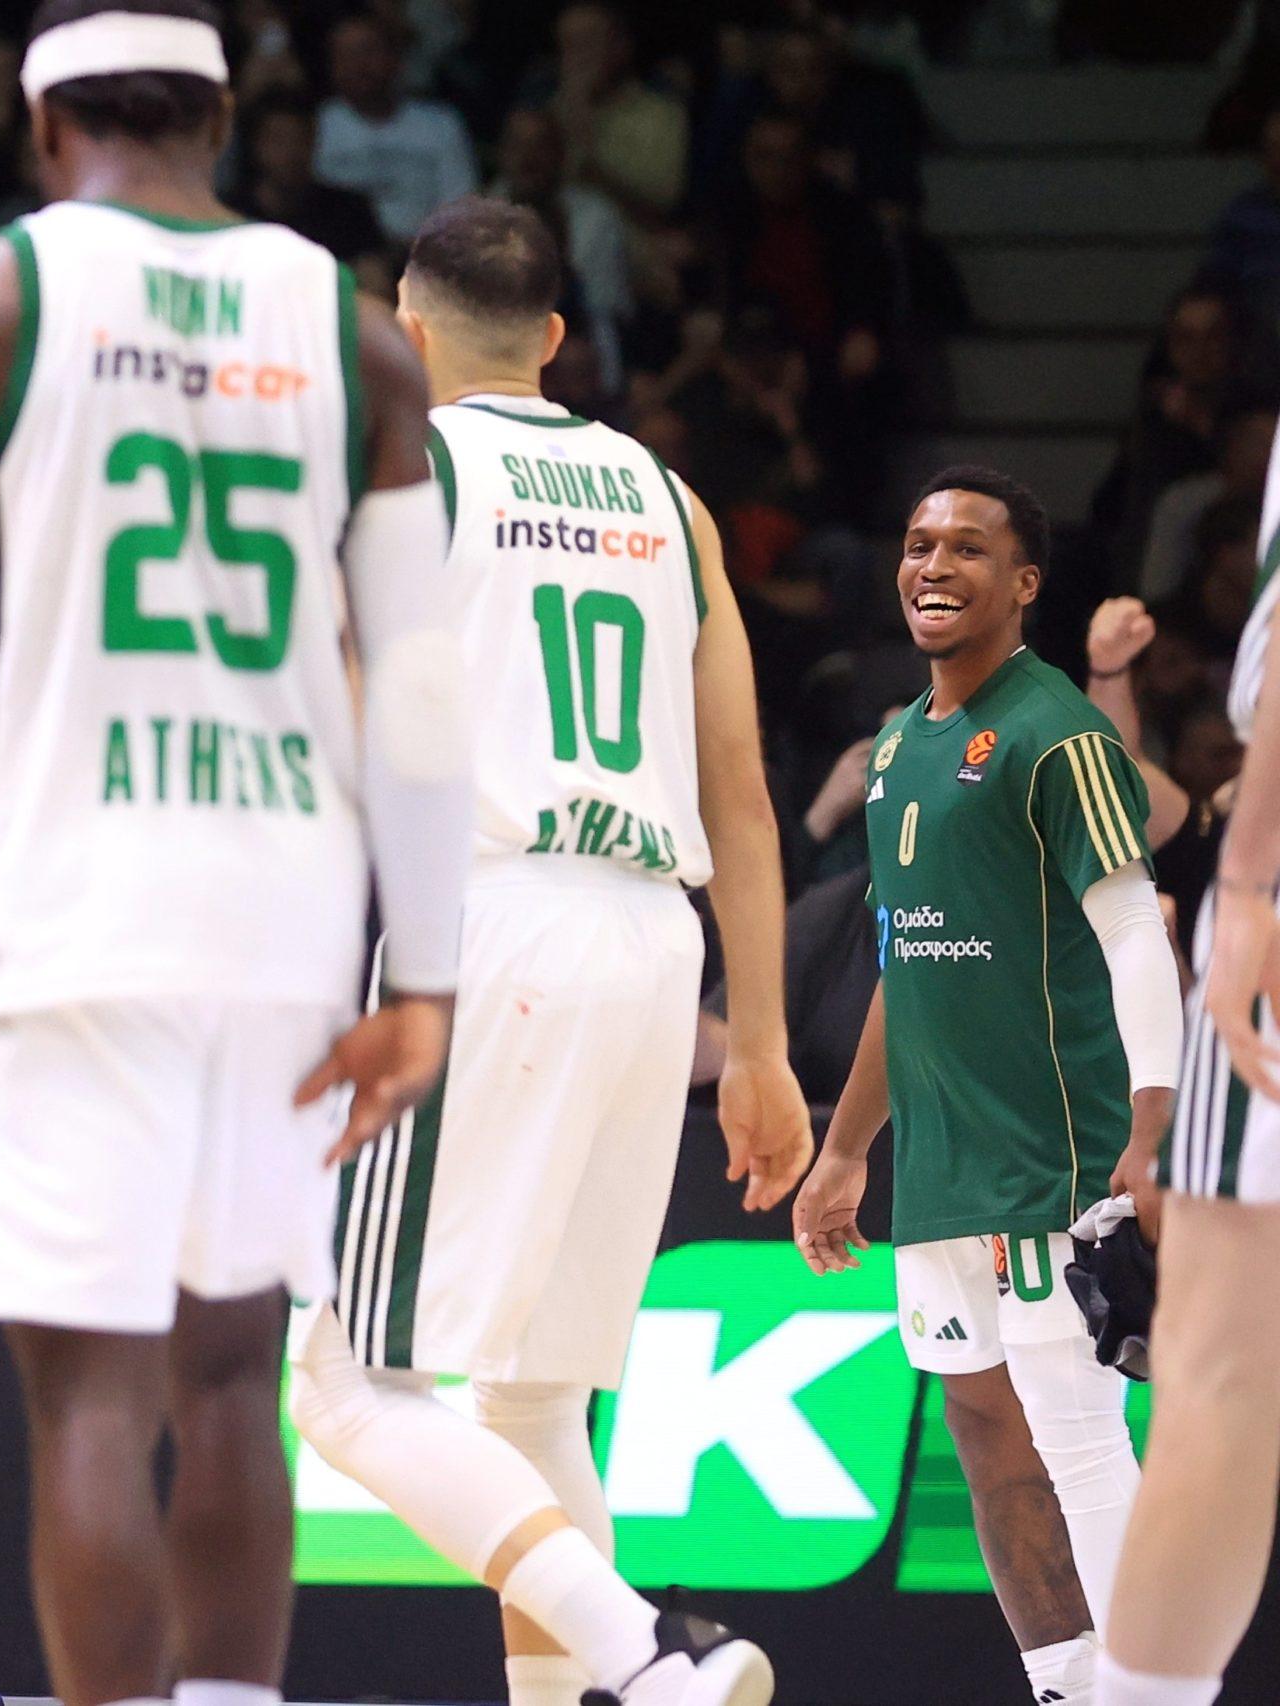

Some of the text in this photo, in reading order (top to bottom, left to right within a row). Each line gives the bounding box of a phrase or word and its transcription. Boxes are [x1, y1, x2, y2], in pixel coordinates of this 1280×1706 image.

[502, 453, 644, 514] SLOUKAS
[102, 431, 303, 672] 25
[496, 508, 666, 562] instacar
[533, 583, 645, 774] 10
[898, 801, 919, 866] 0
[893, 906, 944, 934] Ομάδα
[894, 935, 993, 963] Προσφοράς
